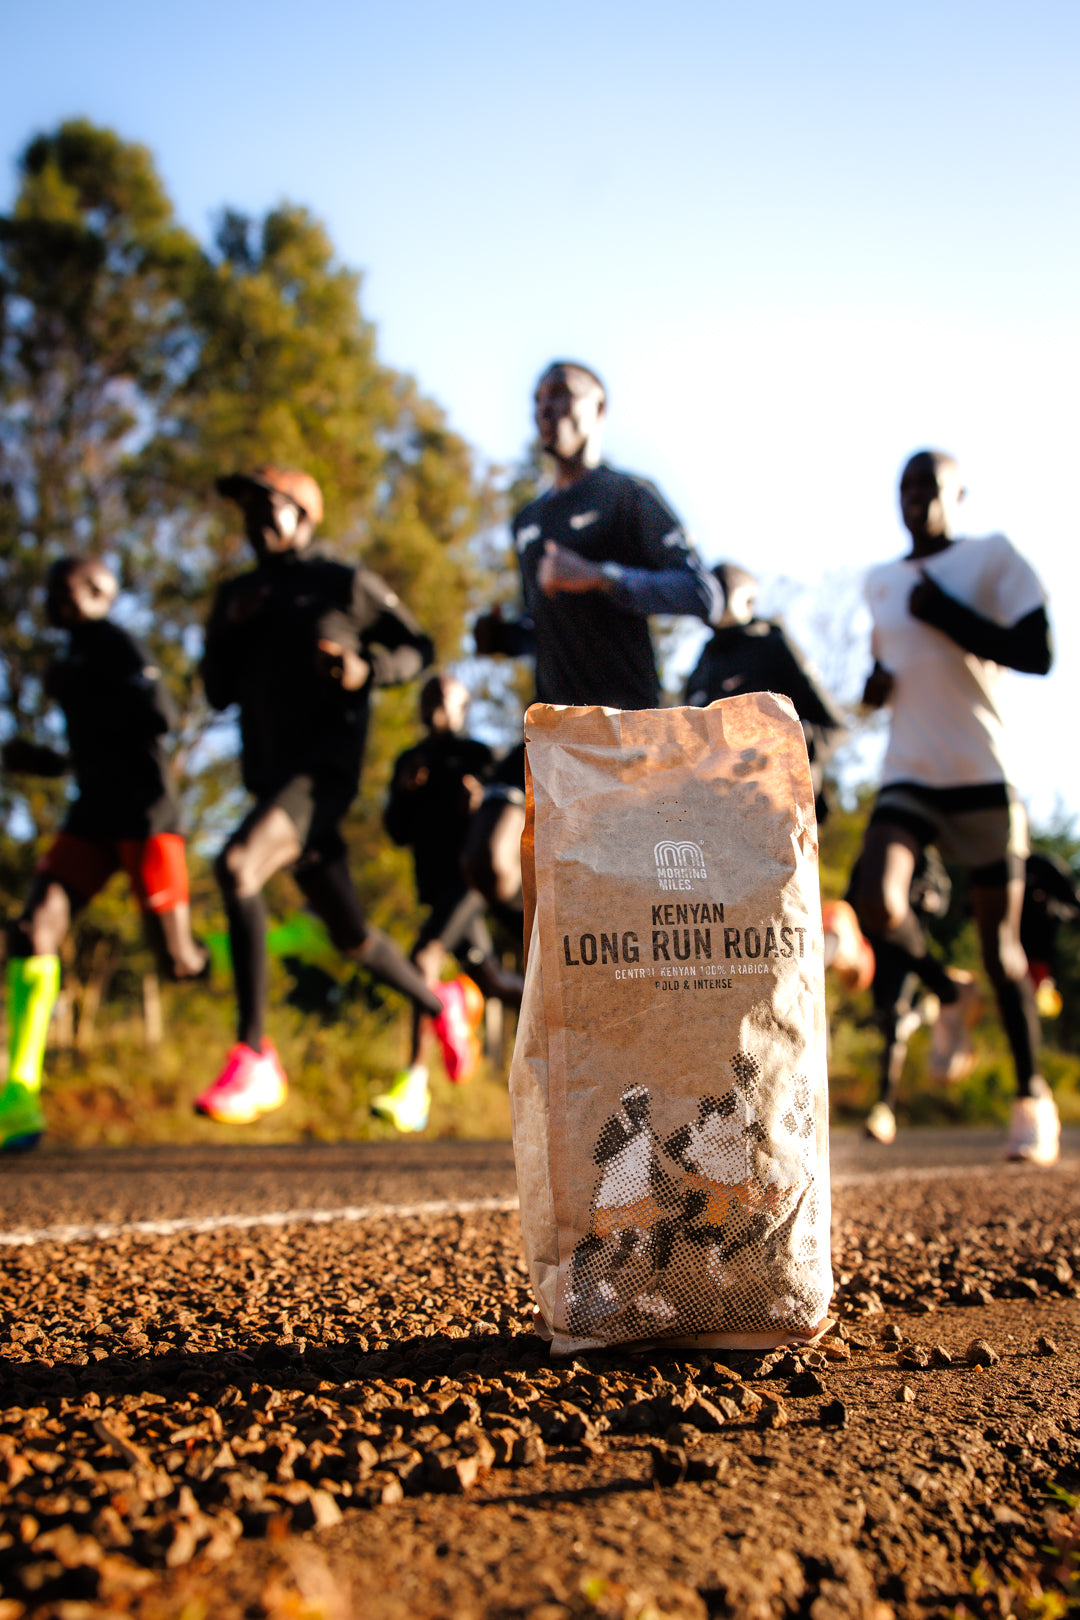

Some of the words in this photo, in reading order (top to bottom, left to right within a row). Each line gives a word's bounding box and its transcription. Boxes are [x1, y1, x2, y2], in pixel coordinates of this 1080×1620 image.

[657, 868, 707, 879] MORNING
[659, 879, 694, 891] MILES.
[651, 903, 725, 925] KENYAN
[563, 931, 640, 966] LONG
[652, 928, 712, 962] RUN
[723, 926, 807, 959] ROAST
[660, 966, 697, 977] KENYAN
[730, 963, 769, 975] ARABICA
[683, 980, 690, 990] &
[694, 978, 733, 990] INTENSE
